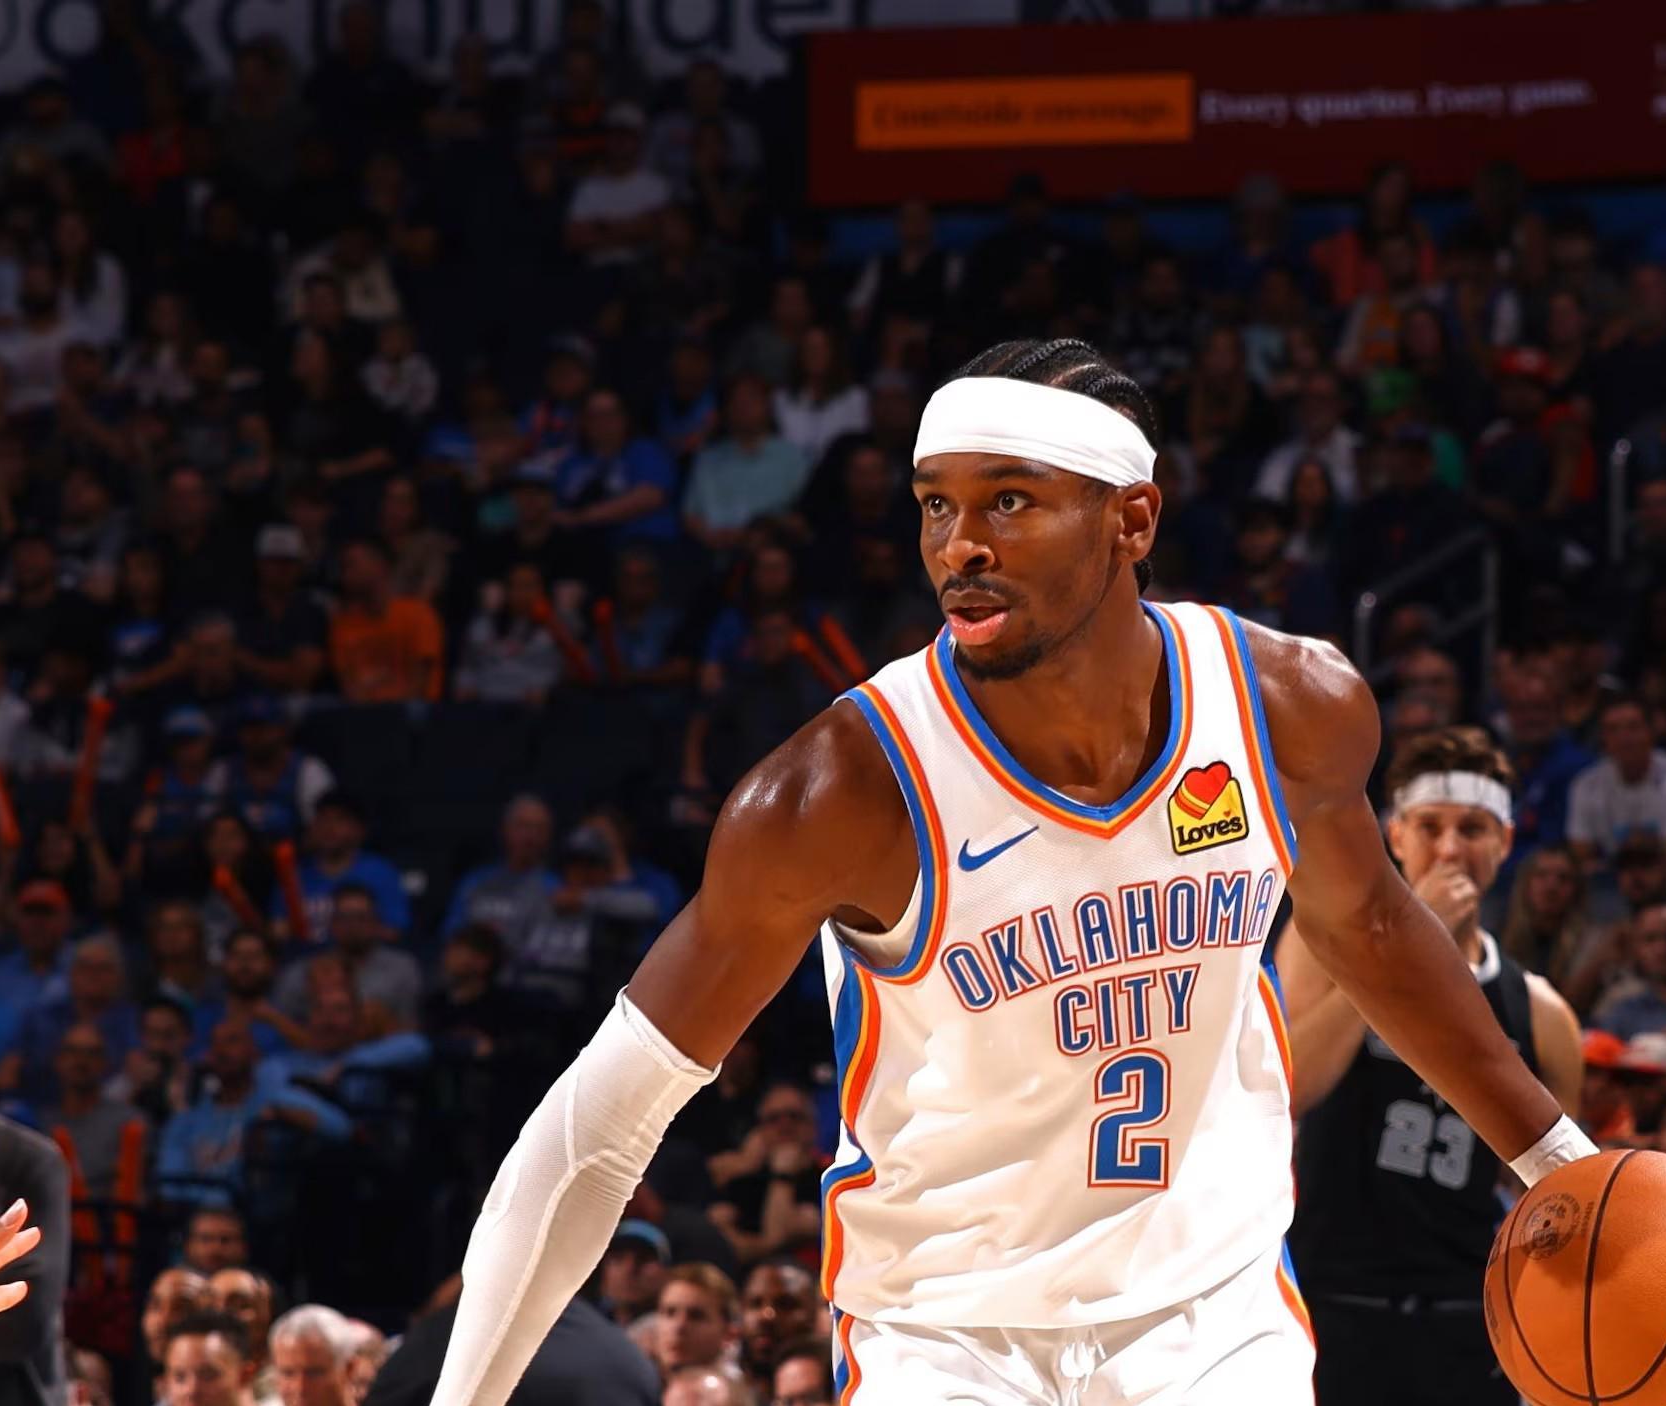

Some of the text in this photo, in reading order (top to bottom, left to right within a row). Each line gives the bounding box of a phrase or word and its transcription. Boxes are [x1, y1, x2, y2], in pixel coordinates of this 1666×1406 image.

[941, 870, 1278, 1013] OKLAHOMA
[1055, 963, 1201, 1056] CITY
[1088, 1048, 1171, 1189] 2
[1375, 1097, 1477, 1192] 23
